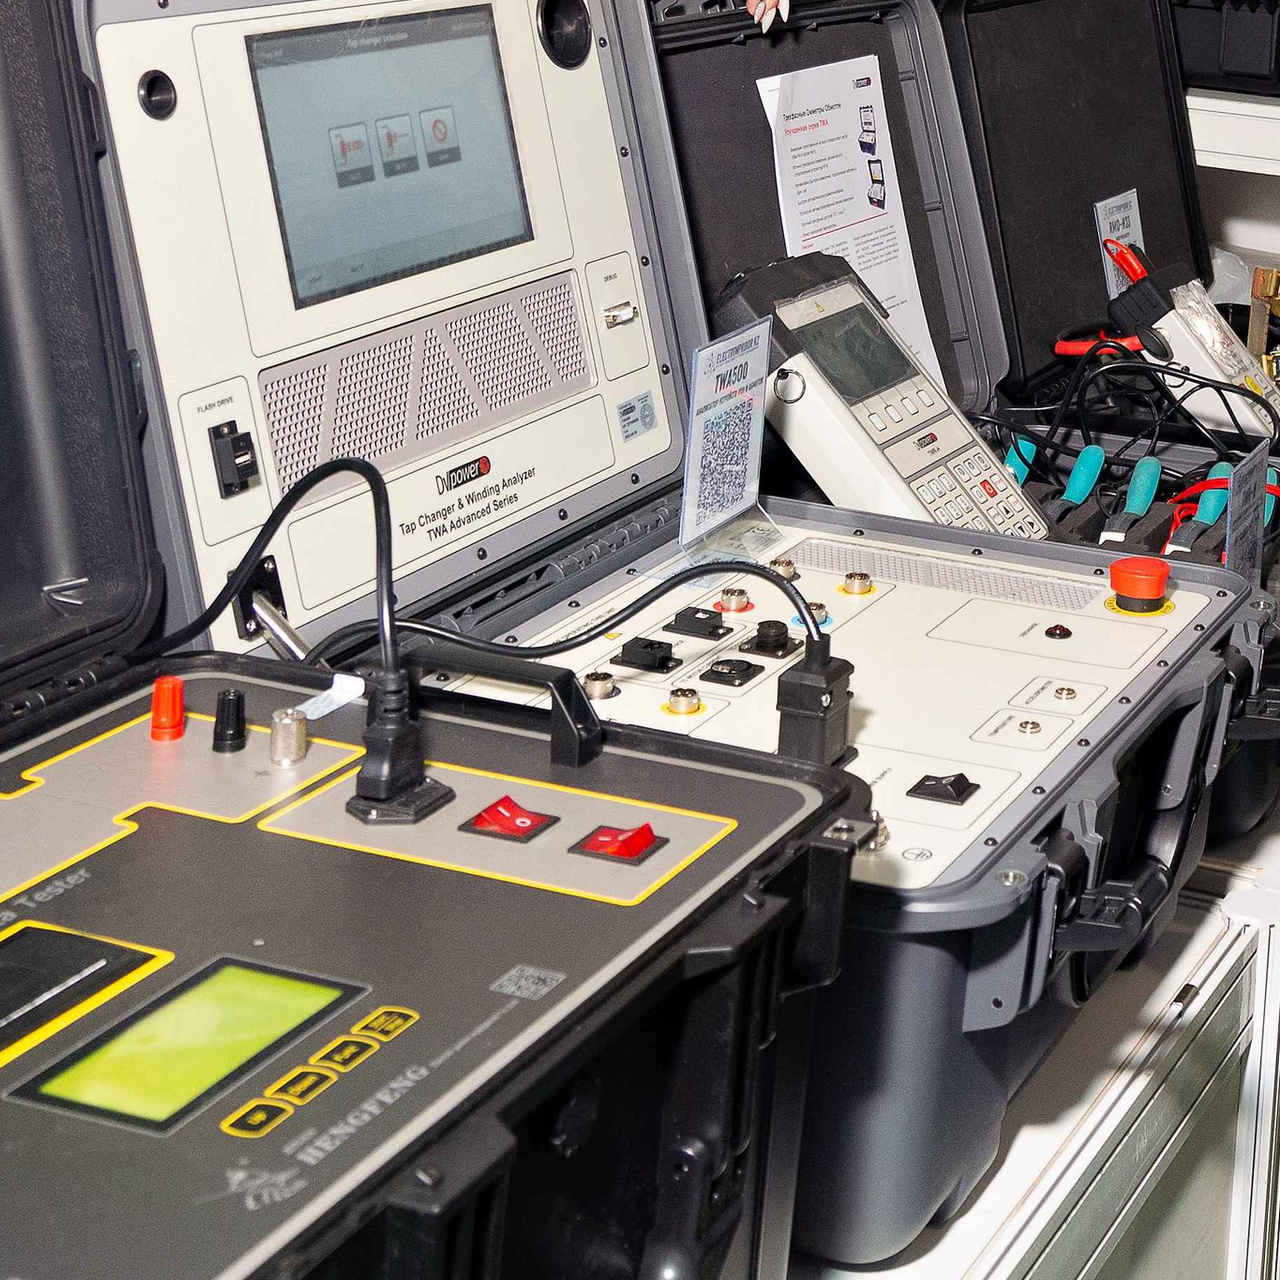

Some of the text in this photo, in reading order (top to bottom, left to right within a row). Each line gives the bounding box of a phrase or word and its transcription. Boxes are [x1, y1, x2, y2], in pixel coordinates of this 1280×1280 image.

[603, 273, 618, 283] DEBUG
[714, 361, 749, 394] TWA500
[197, 396, 234, 414] FLASH DRIVE
[399, 466, 536, 536] Tap Changer & Winding Analyzer
[427, 492, 519, 541] TWA Advanced Series
[13, 869, 90, 908] Tester
